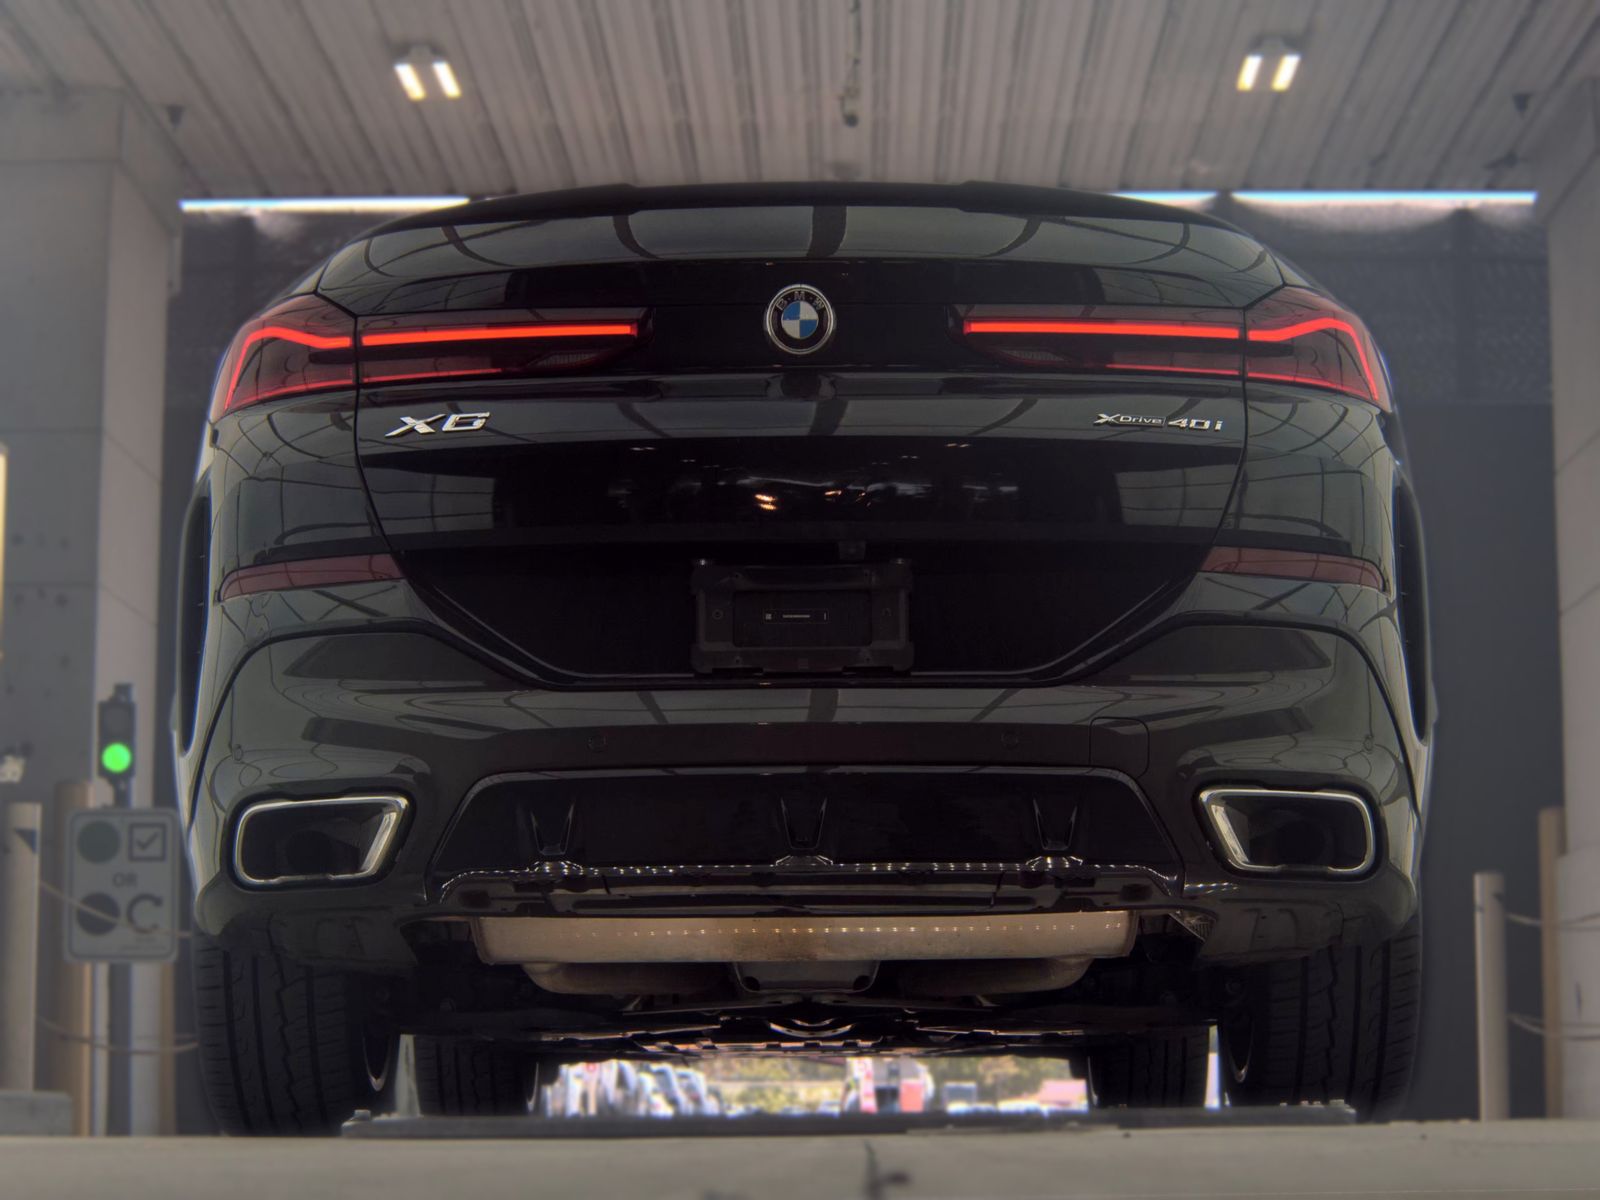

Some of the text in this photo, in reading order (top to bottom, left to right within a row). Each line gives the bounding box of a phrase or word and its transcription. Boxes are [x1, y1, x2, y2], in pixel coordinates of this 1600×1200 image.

[776, 291, 825, 311] BMW
[385, 412, 490, 437] X6
[1167, 418, 1223, 431] 40i
[112, 871, 138, 888] OR
